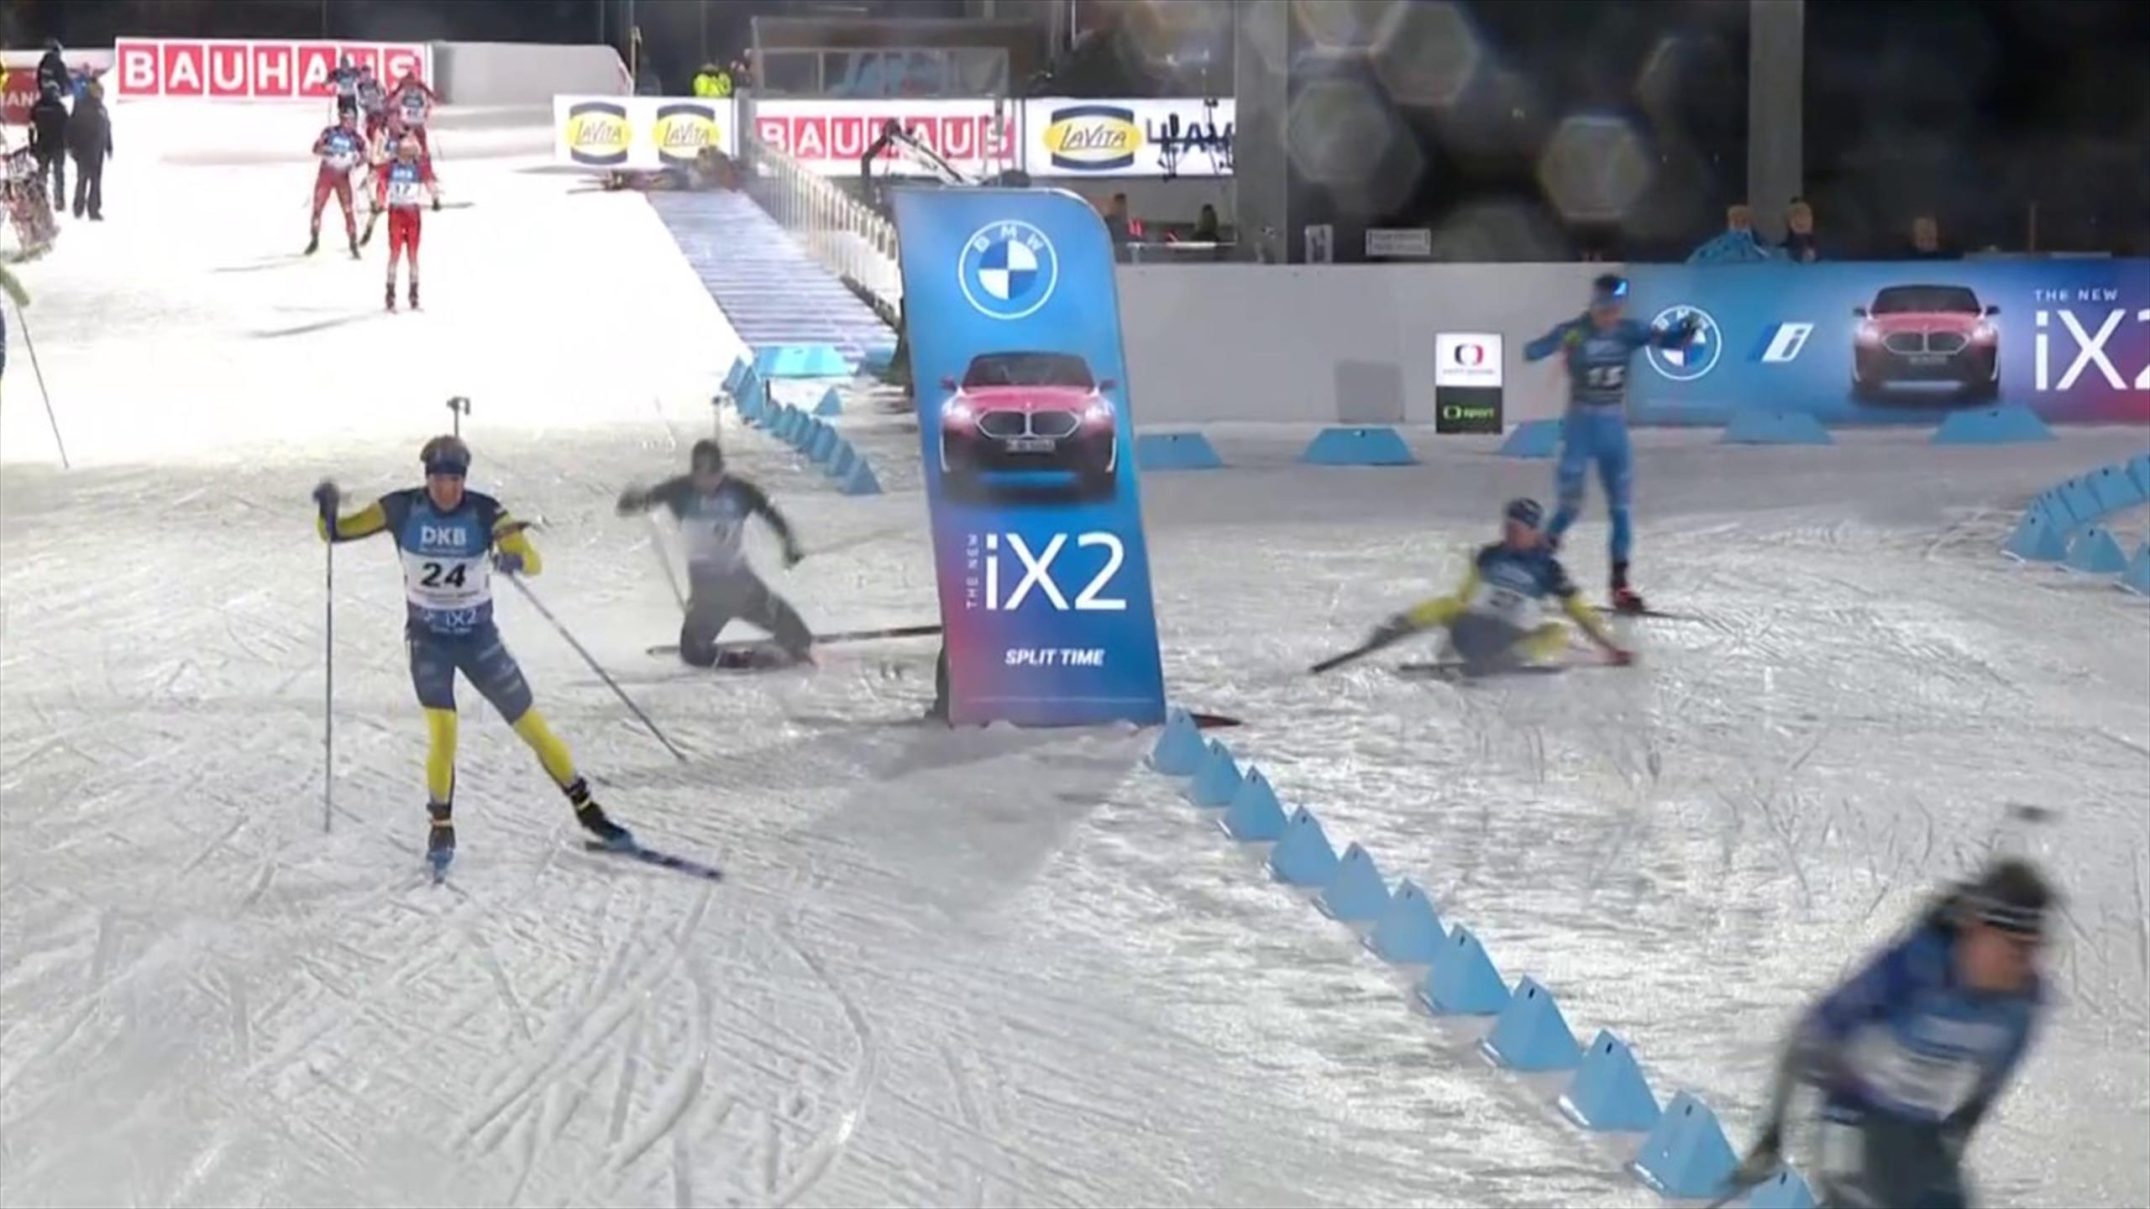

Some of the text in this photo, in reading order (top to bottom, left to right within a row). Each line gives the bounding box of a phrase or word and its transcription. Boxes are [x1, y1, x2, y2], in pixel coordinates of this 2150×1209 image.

[974, 223, 1045, 253] BMW
[2034, 288, 2118, 301] THE NEW
[421, 526, 466, 546] DKB
[420, 562, 466, 588] 24
[966, 533, 979, 609] THE NEW
[985, 531, 1127, 611] iX2
[1005, 649, 1106, 667] SPLIT TIME
